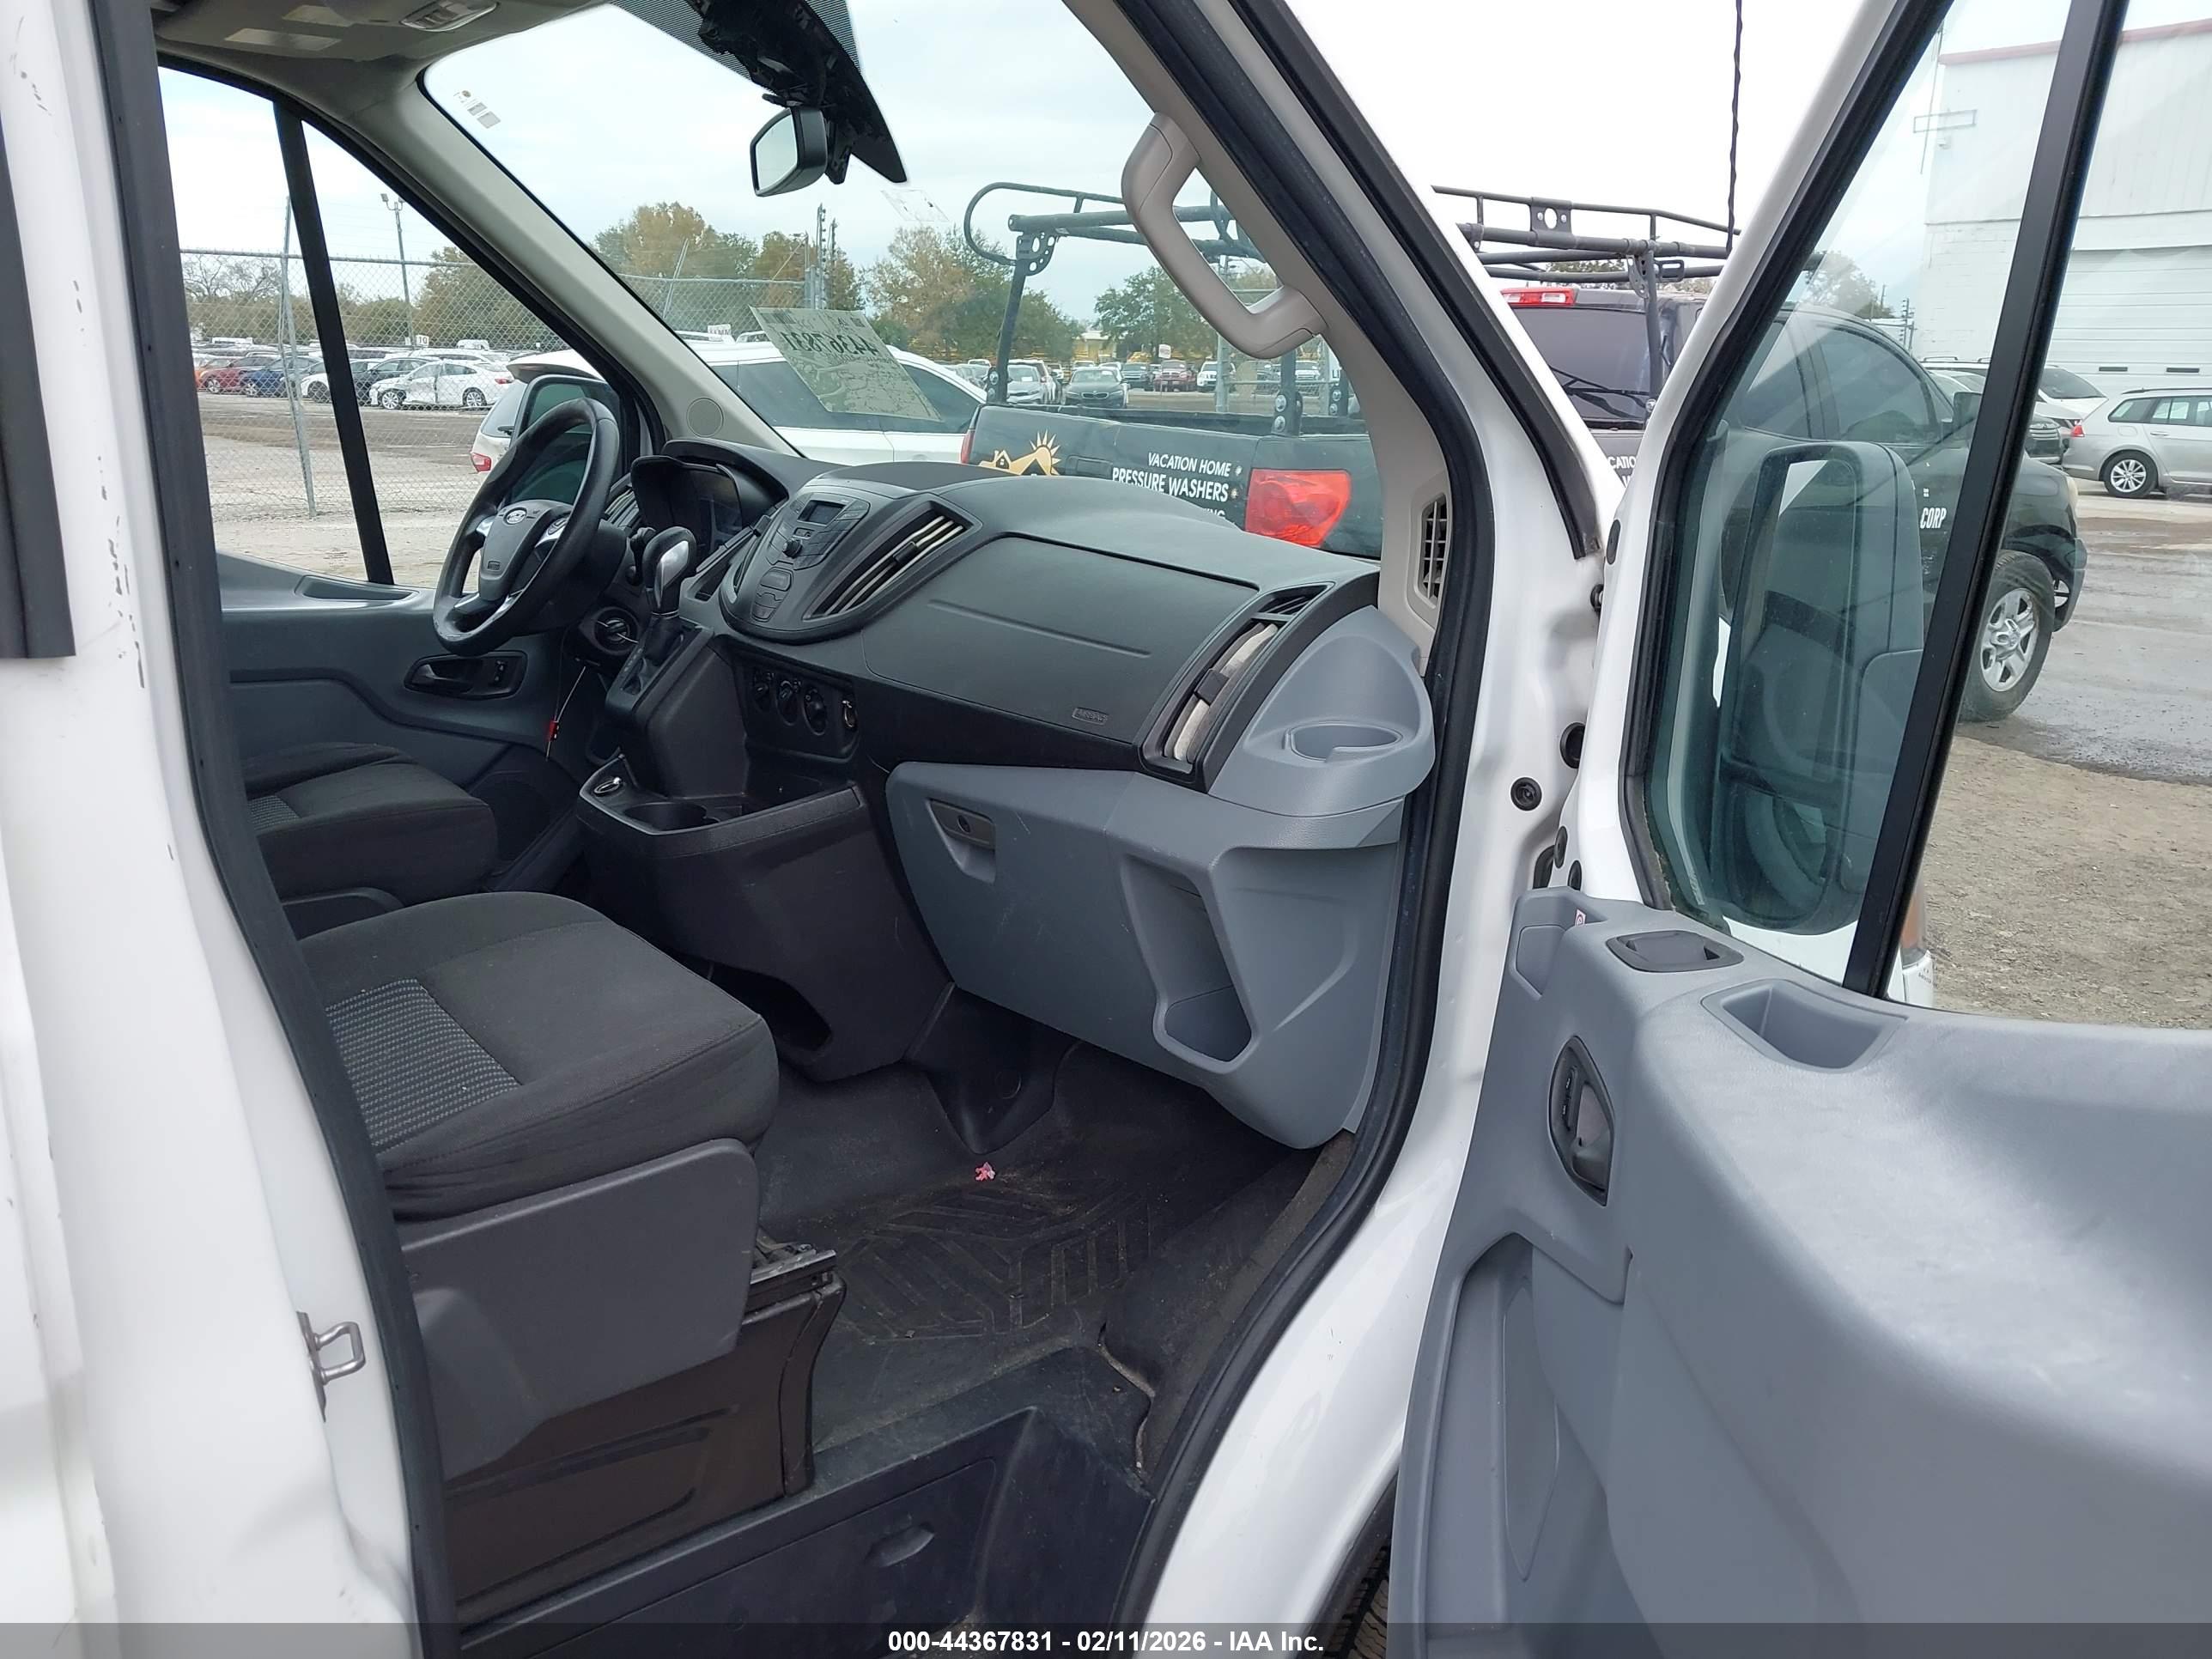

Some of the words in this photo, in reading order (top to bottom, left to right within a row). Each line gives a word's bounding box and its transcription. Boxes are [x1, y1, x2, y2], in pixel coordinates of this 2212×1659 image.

[1148, 452, 1197, 472] VACATION
[1199, 459, 1231, 477] HOME
[1607, 456, 1637, 469] CATIO
[1112, 467, 1166, 492] PRESSURE
[1168, 477, 1229, 502] WASHERS
[1919, 507, 1948, 529] CORP
